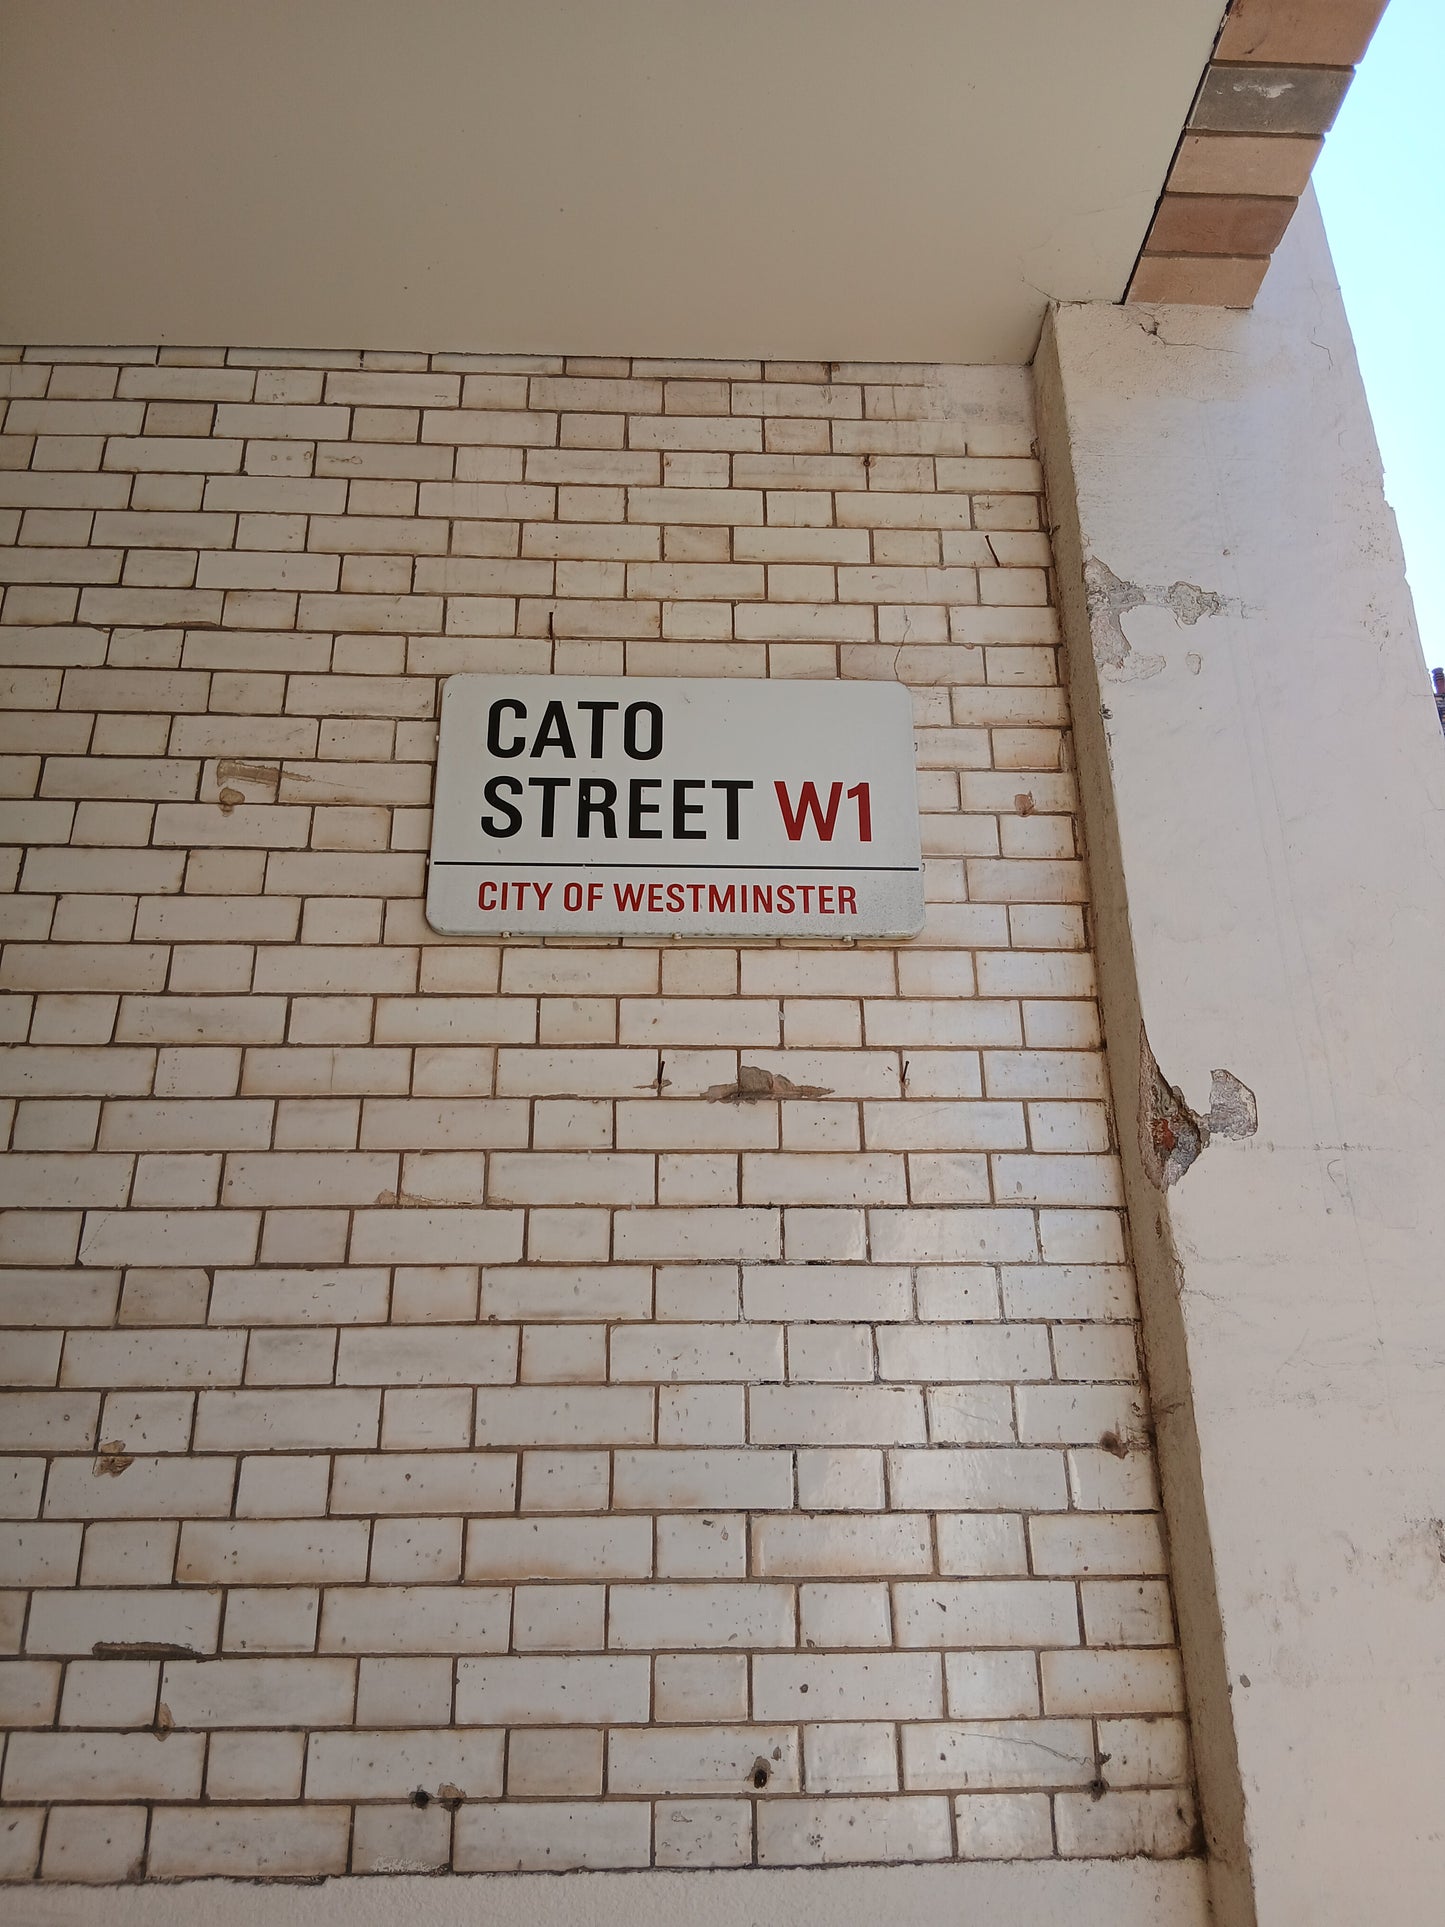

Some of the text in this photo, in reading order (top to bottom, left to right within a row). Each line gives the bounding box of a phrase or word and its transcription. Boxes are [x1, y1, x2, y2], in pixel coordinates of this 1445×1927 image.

[487, 699, 663, 760] CATO
[481, 776, 872, 842] STREET W1
[478, 882, 857, 915] CITY OF WESTMINSTER
